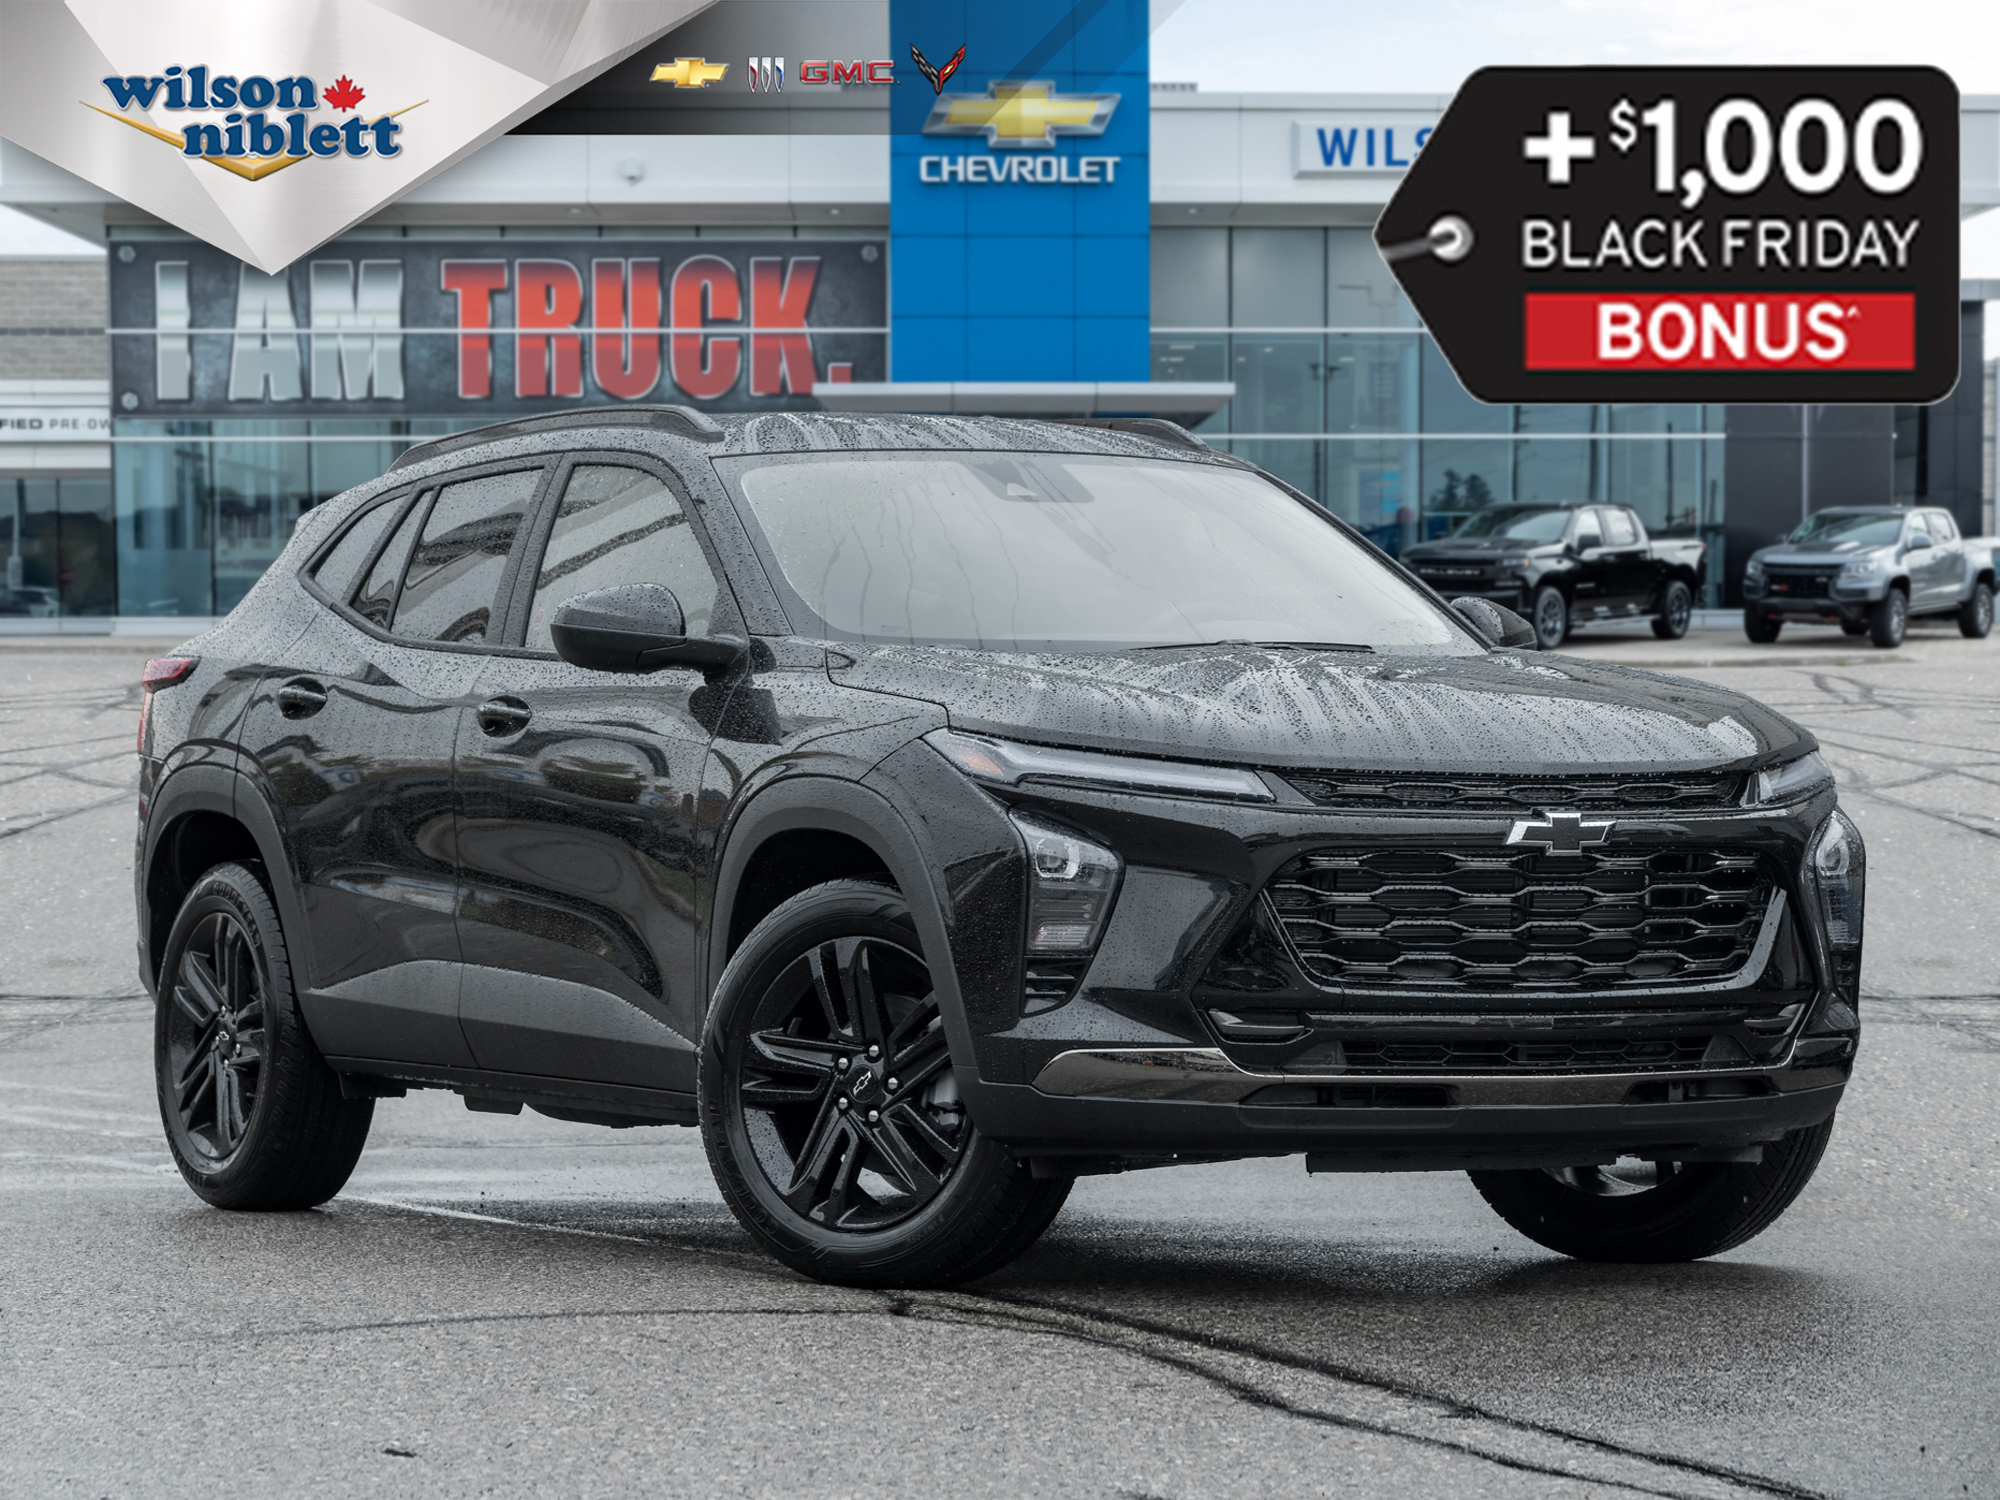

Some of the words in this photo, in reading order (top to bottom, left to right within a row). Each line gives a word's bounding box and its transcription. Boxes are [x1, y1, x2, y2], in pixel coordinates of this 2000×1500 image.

[918, 155, 1121, 185] CHEVROLET
[155, 260, 191, 400] I
[228, 259, 404, 401] AM
